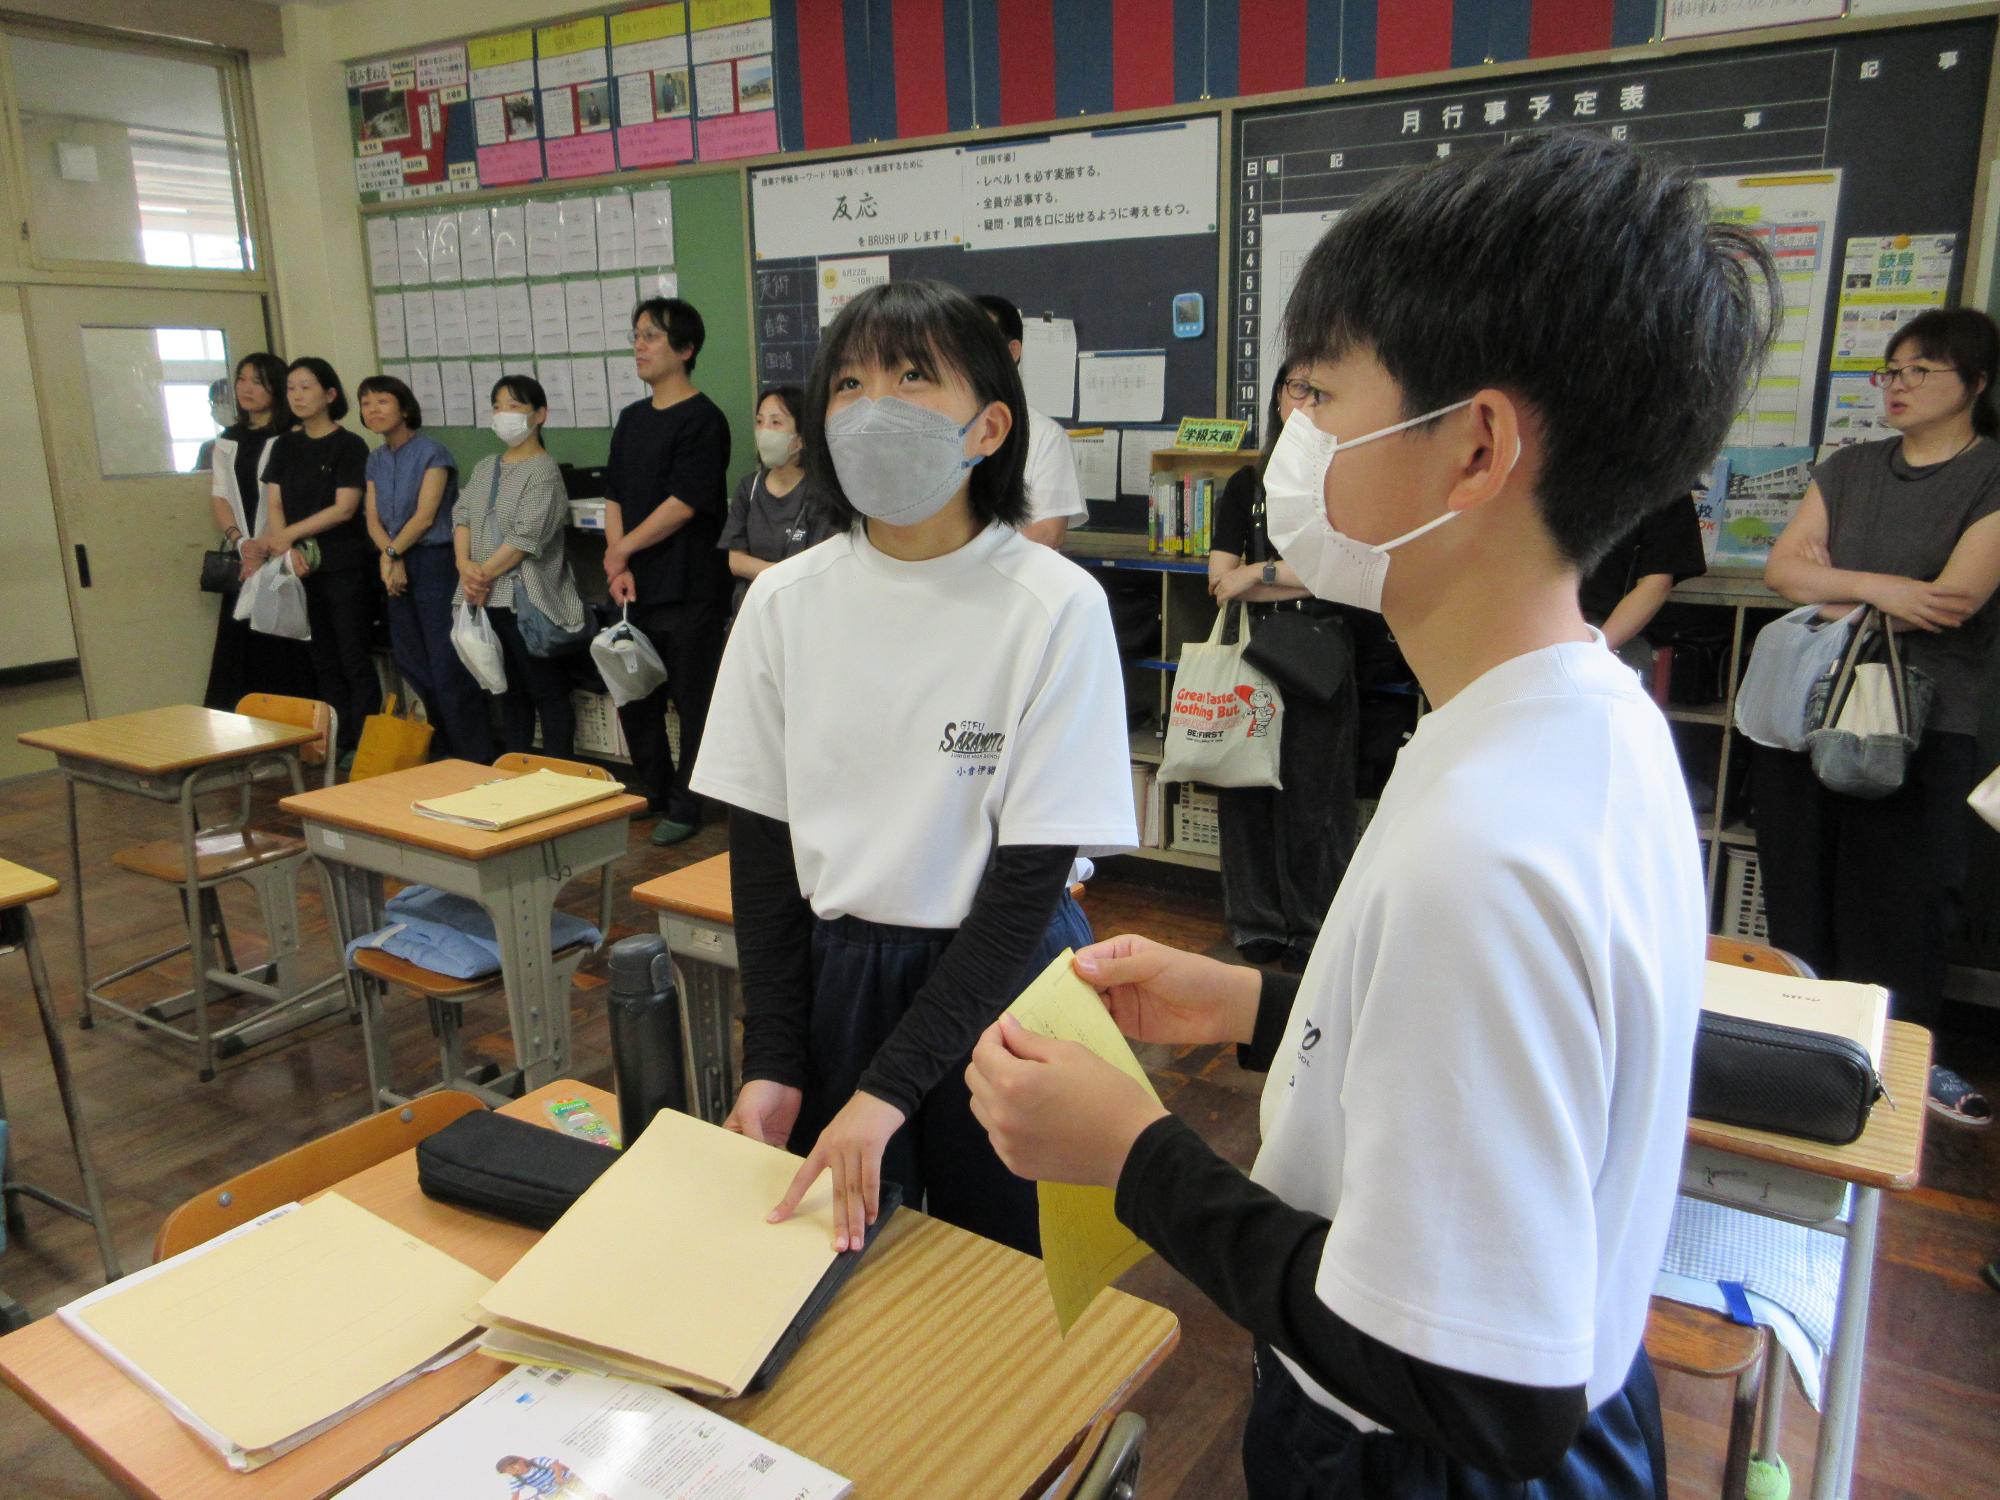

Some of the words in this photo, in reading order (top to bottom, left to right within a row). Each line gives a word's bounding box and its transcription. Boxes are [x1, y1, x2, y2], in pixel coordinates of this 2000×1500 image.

[1860, 60, 1880, 80] 記
[1401, 85, 1647, 136] 月行事予定表
[1330, 153, 1343, 169] 記
[1247, 162, 1258, 176] 日
[1248, 185, 1254, 199] 1
[832, 191, 878, 221] 反応
[1247, 207, 1255, 222] 2
[868, 232, 896, 247] BRUSH
[898, 232, 909, 244] UP
[1247, 230, 1255, 244] 3
[1246, 253, 1254, 267] 4
[1246, 276, 1253, 289] 5
[1245, 297, 1253, 311] 6
[1245, 320, 1252, 334] 7
[1244, 343, 1251, 356] 8
[1244, 364, 1252, 378] 9
[1241, 385, 1254, 400] 10
[1184, 428, 1236, 443] 学級文庫
[1174, 701, 1214, 721] Nothing
[960, 720, 985, 732] GIFU
